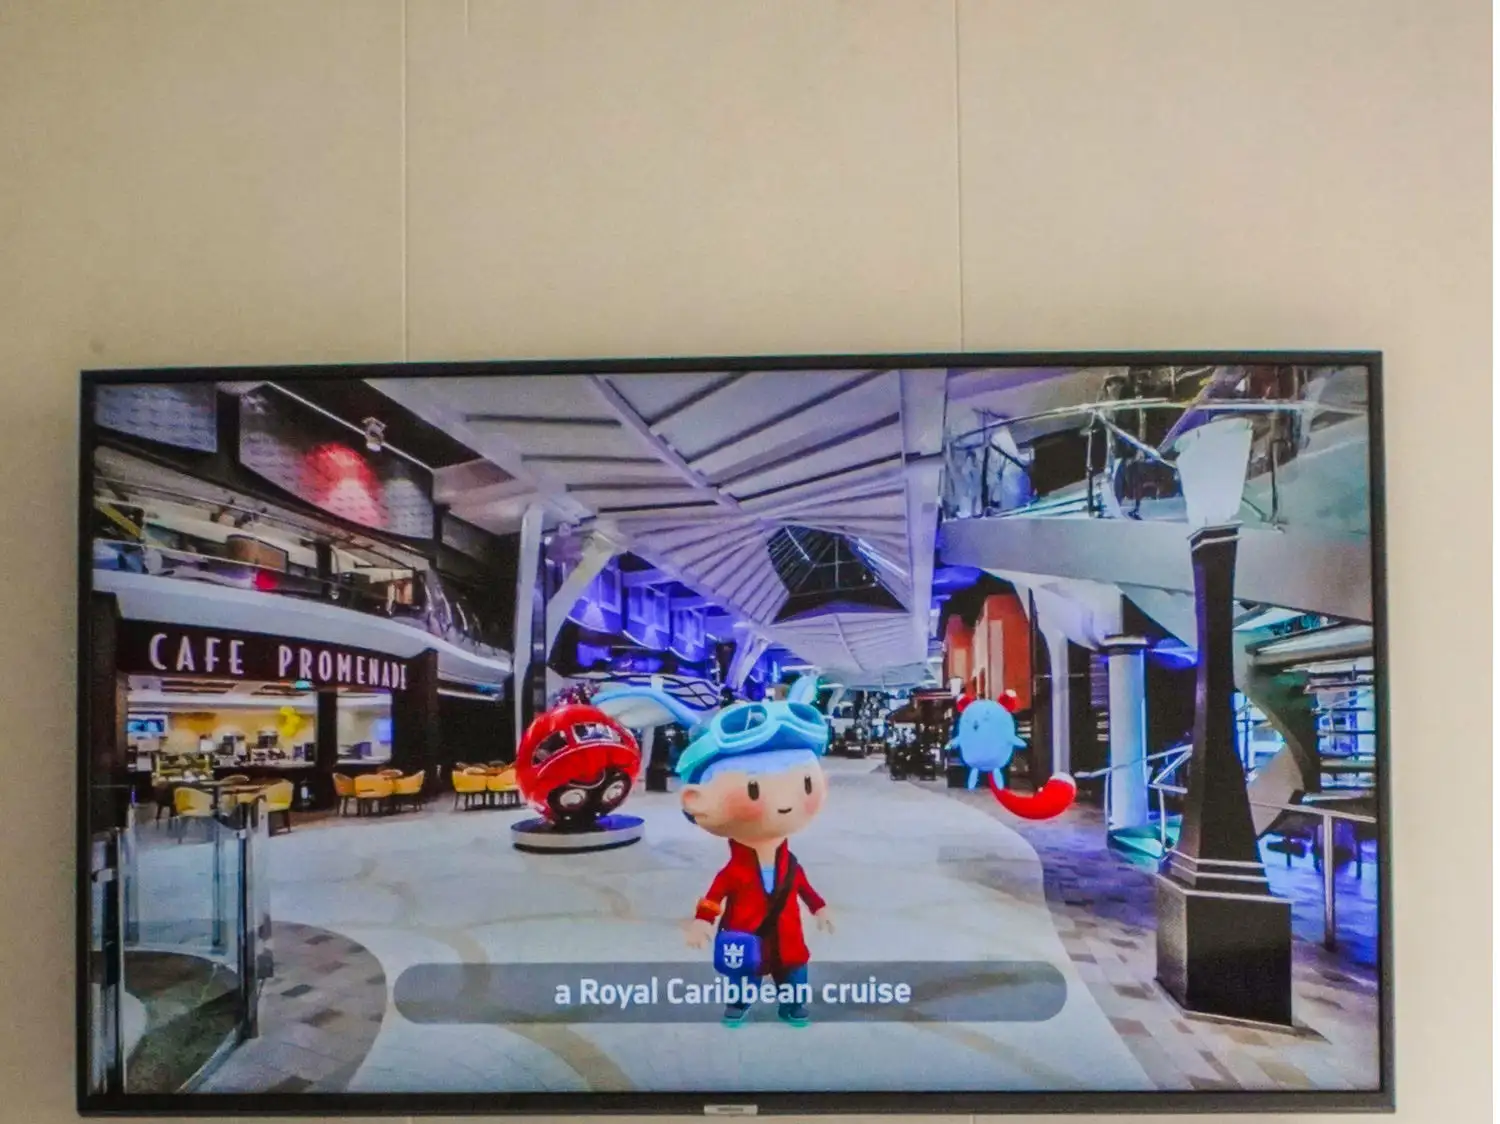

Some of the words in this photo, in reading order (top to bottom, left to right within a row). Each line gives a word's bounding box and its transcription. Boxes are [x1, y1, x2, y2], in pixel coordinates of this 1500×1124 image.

[149, 633, 245, 675] CAFE
[278, 644, 408, 691] PROMENADE
[554, 983, 571, 1005] a
[580, 976, 658, 1010] Royal
[667, 976, 813, 1005] Caribbean
[822, 976, 912, 1004] cruise
